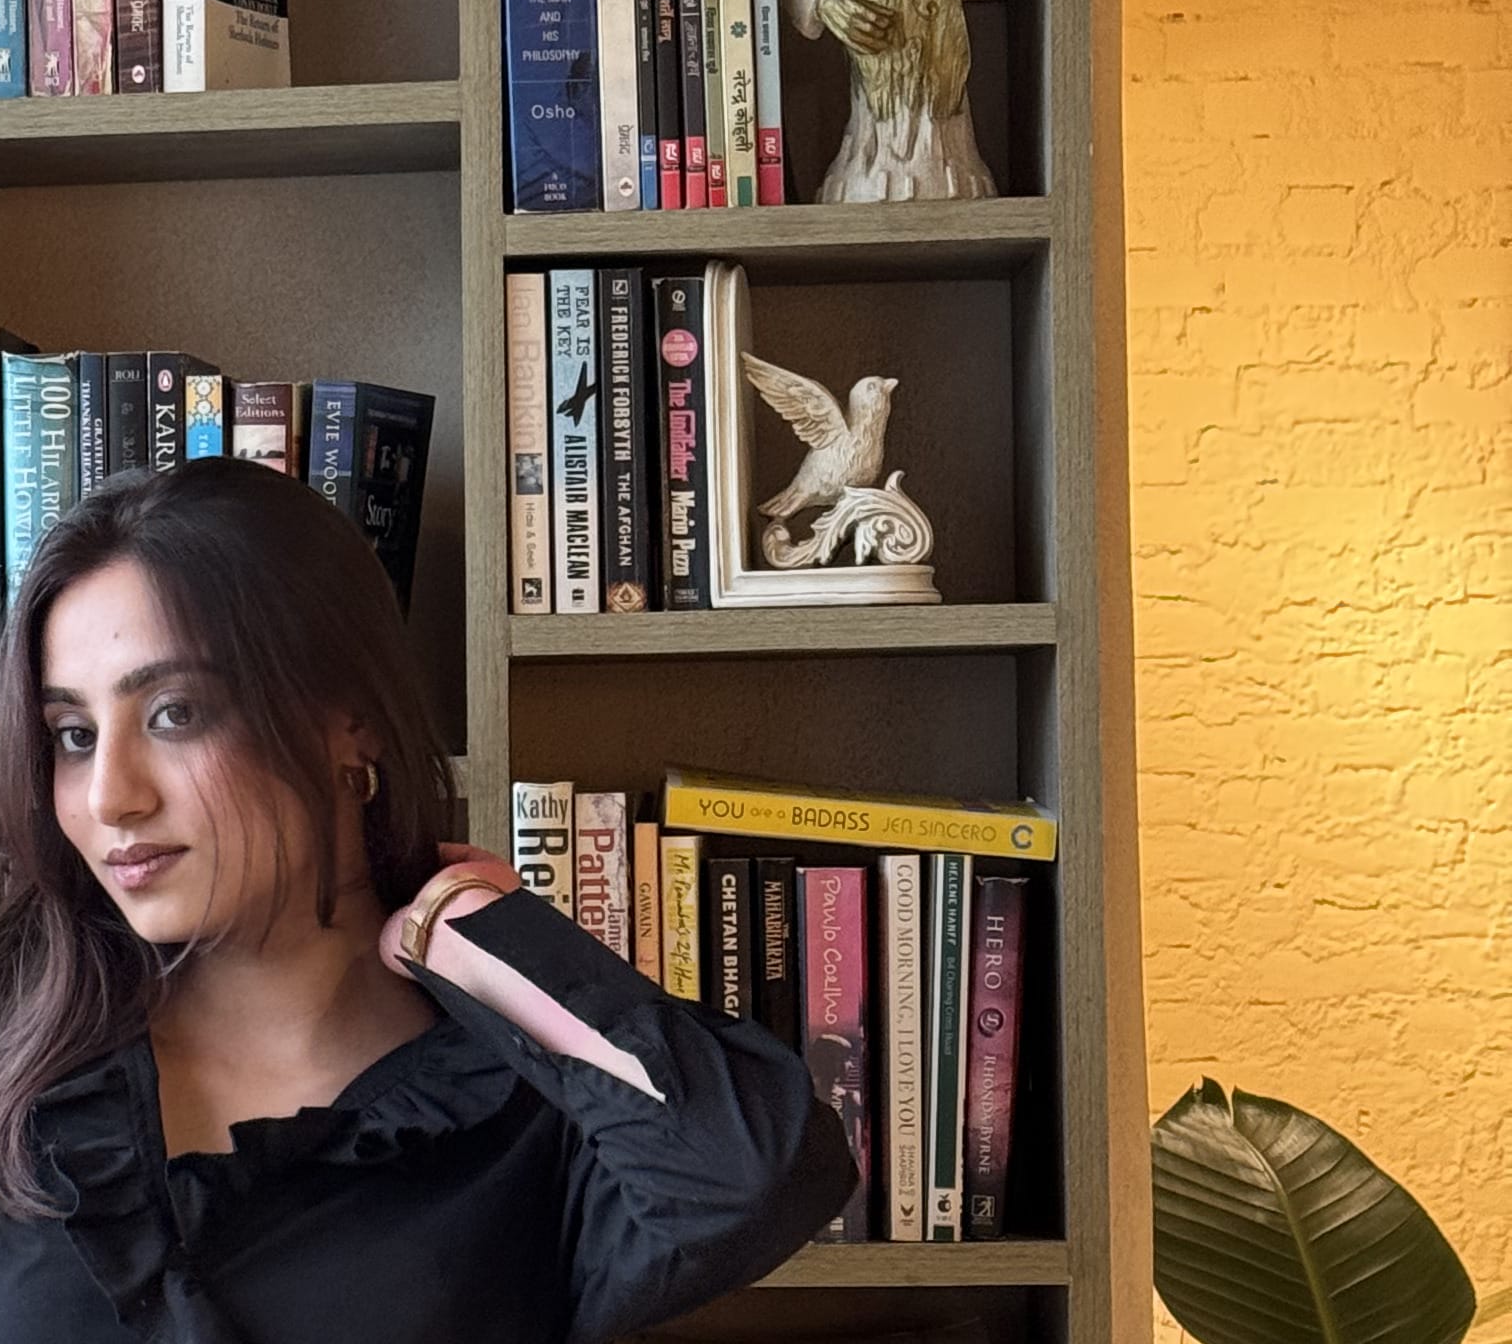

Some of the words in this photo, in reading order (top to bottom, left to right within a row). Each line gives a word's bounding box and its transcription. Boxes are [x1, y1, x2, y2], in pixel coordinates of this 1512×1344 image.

[731, 70, 748, 105] नरेन्द्र
[531, 105, 575, 119] Osho
[732, 108, 752, 152] कोहली
[556, 285, 570, 319] THE
[575, 286, 590, 330] FEAR
[557, 326, 571, 358] KEY
[576, 337, 590, 356] IS
[610, 307, 630, 383] FREDERICK
[40, 376, 71, 419] 100
[668, 380, 692, 408] The
[613, 388, 631, 461] FORSYTH
[667, 410, 696, 481] Godfather
[564, 435, 587, 504] ALISTAIR
[618, 473, 630, 502] THE
[671, 491, 696, 534] Mario
[566, 510, 588, 579] MACLEAN
[618, 507, 632, 566] AFGHAN
[673, 539, 696, 576] Puzo
[517, 792, 568, 824] Kathy
[699, 798, 745, 819] YOU
[792, 807, 870, 832] BADASS
[578, 828, 615, 942] Patter
[895, 864, 914, 922] GOOD
[639, 883, 651, 937] GAWAIN
[722, 874, 737, 950] CHETAN
[820, 876, 841, 941] Paulo
[984, 915, 1005, 990] HERO
[823, 948, 842, 1024] Coelho
[895, 927, 915, 1025] MORNING,
[897, 1039, 915, 1092] LOVE
[897, 1097, 916, 1137] YOU
